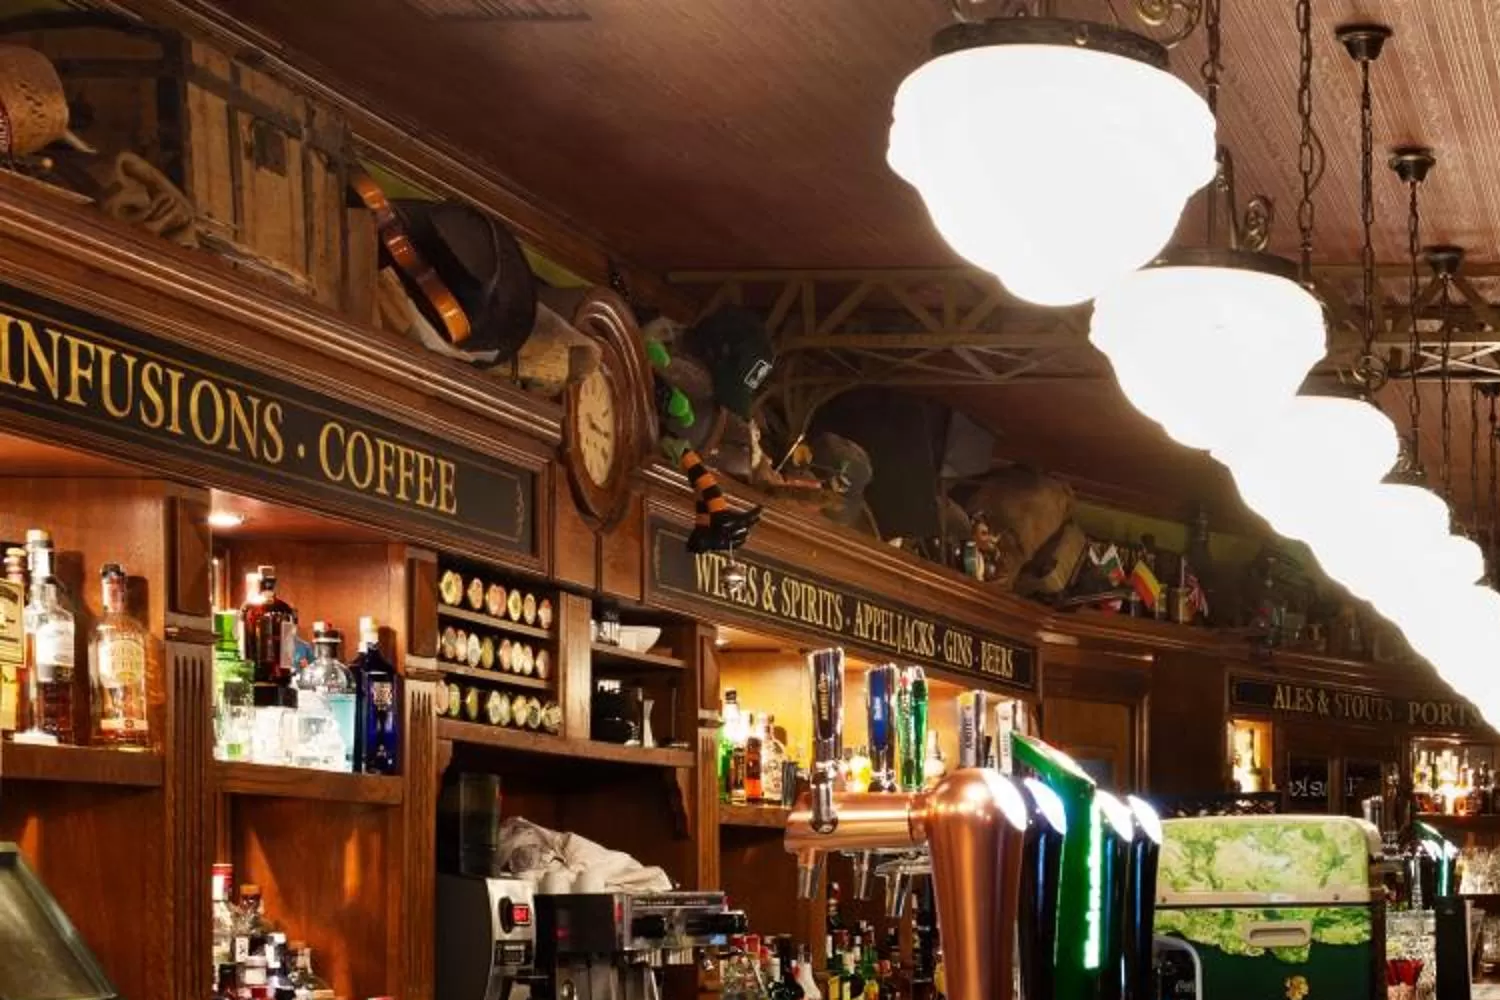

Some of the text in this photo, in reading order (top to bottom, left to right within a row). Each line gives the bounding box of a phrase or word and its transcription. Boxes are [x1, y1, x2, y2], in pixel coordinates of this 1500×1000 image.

[0, 314, 458, 515] INFUSIONS COFFEE
[695, 553, 1013, 679] WIES & SPIRITS APPELJACKS GINS BEERS
[1272, 684, 1313, 713] ALES
[1315, 690, 1329, 716] &
[1334, 691, 1392, 721] STOUTS
